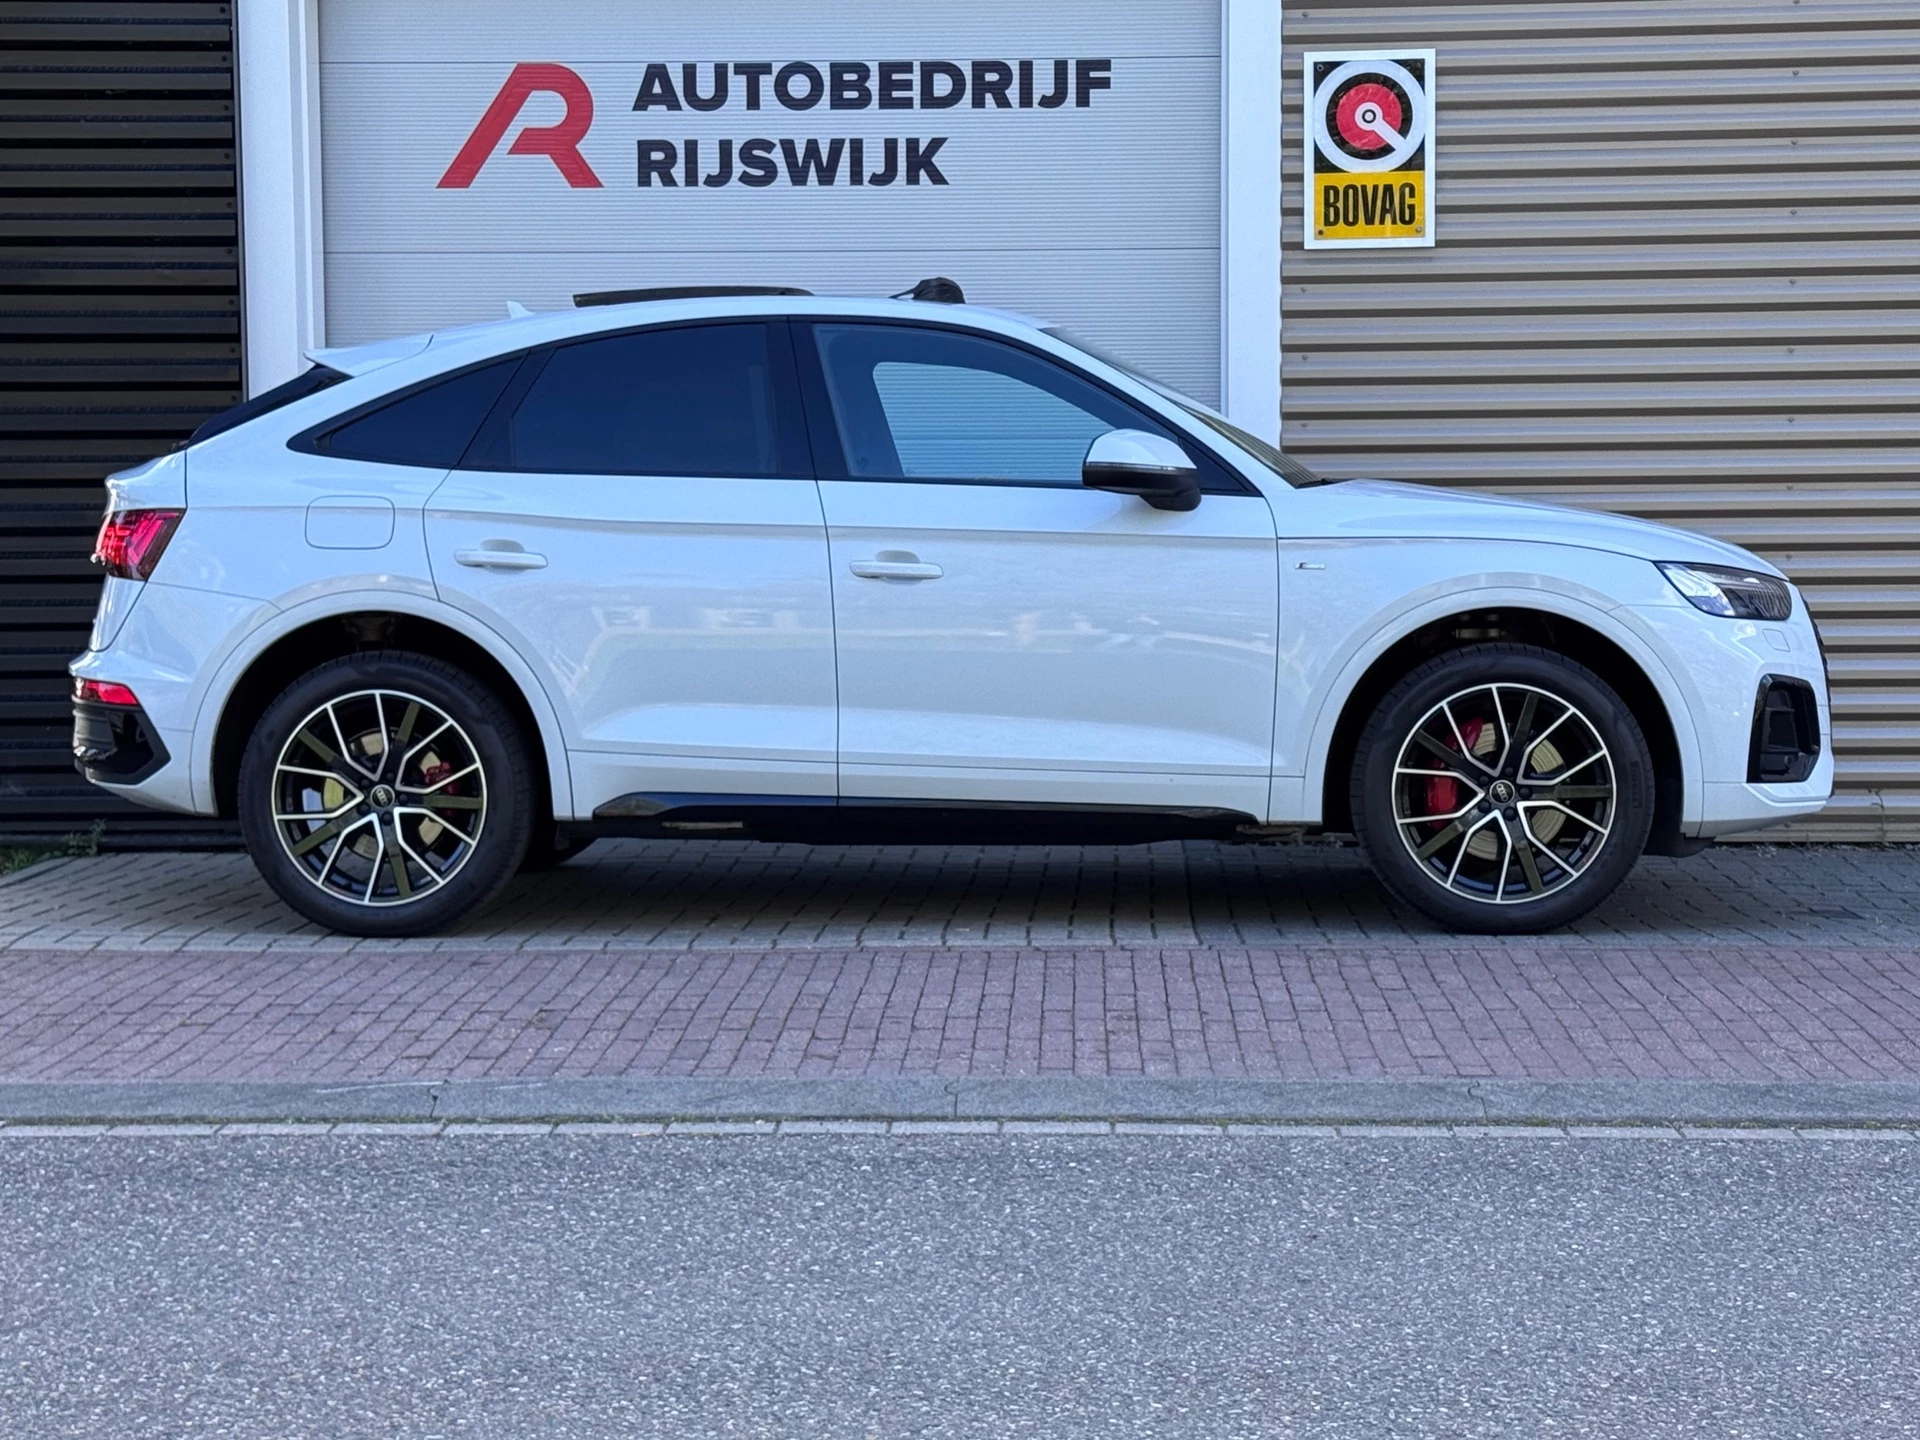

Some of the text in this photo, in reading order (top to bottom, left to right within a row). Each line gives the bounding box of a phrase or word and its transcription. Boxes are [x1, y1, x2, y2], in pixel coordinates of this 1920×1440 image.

[632, 59, 1112, 112] AUTOBEDRIJF
[636, 137, 950, 188] RIJSWIJK
[1323, 182, 1416, 227] BOVAG
